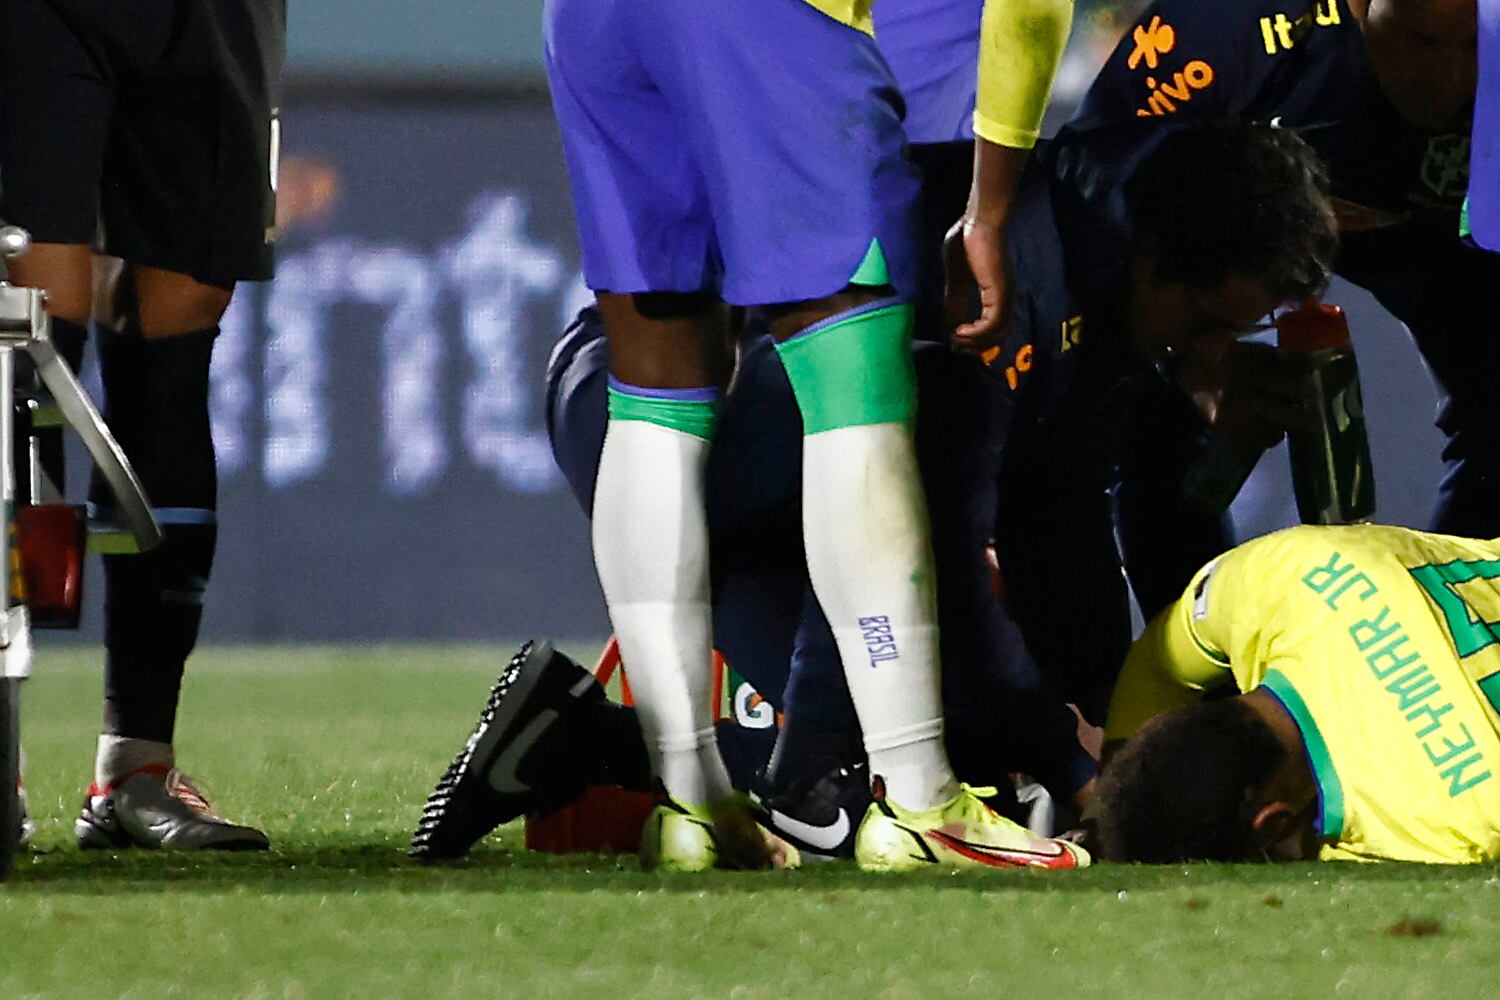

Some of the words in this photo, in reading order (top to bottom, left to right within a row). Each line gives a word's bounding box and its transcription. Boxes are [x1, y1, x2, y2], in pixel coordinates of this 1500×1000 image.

[1300, 551, 1379, 612] JR
[858, 614, 900, 668] BRASIL
[1347, 603, 1493, 798] NEYMAR
